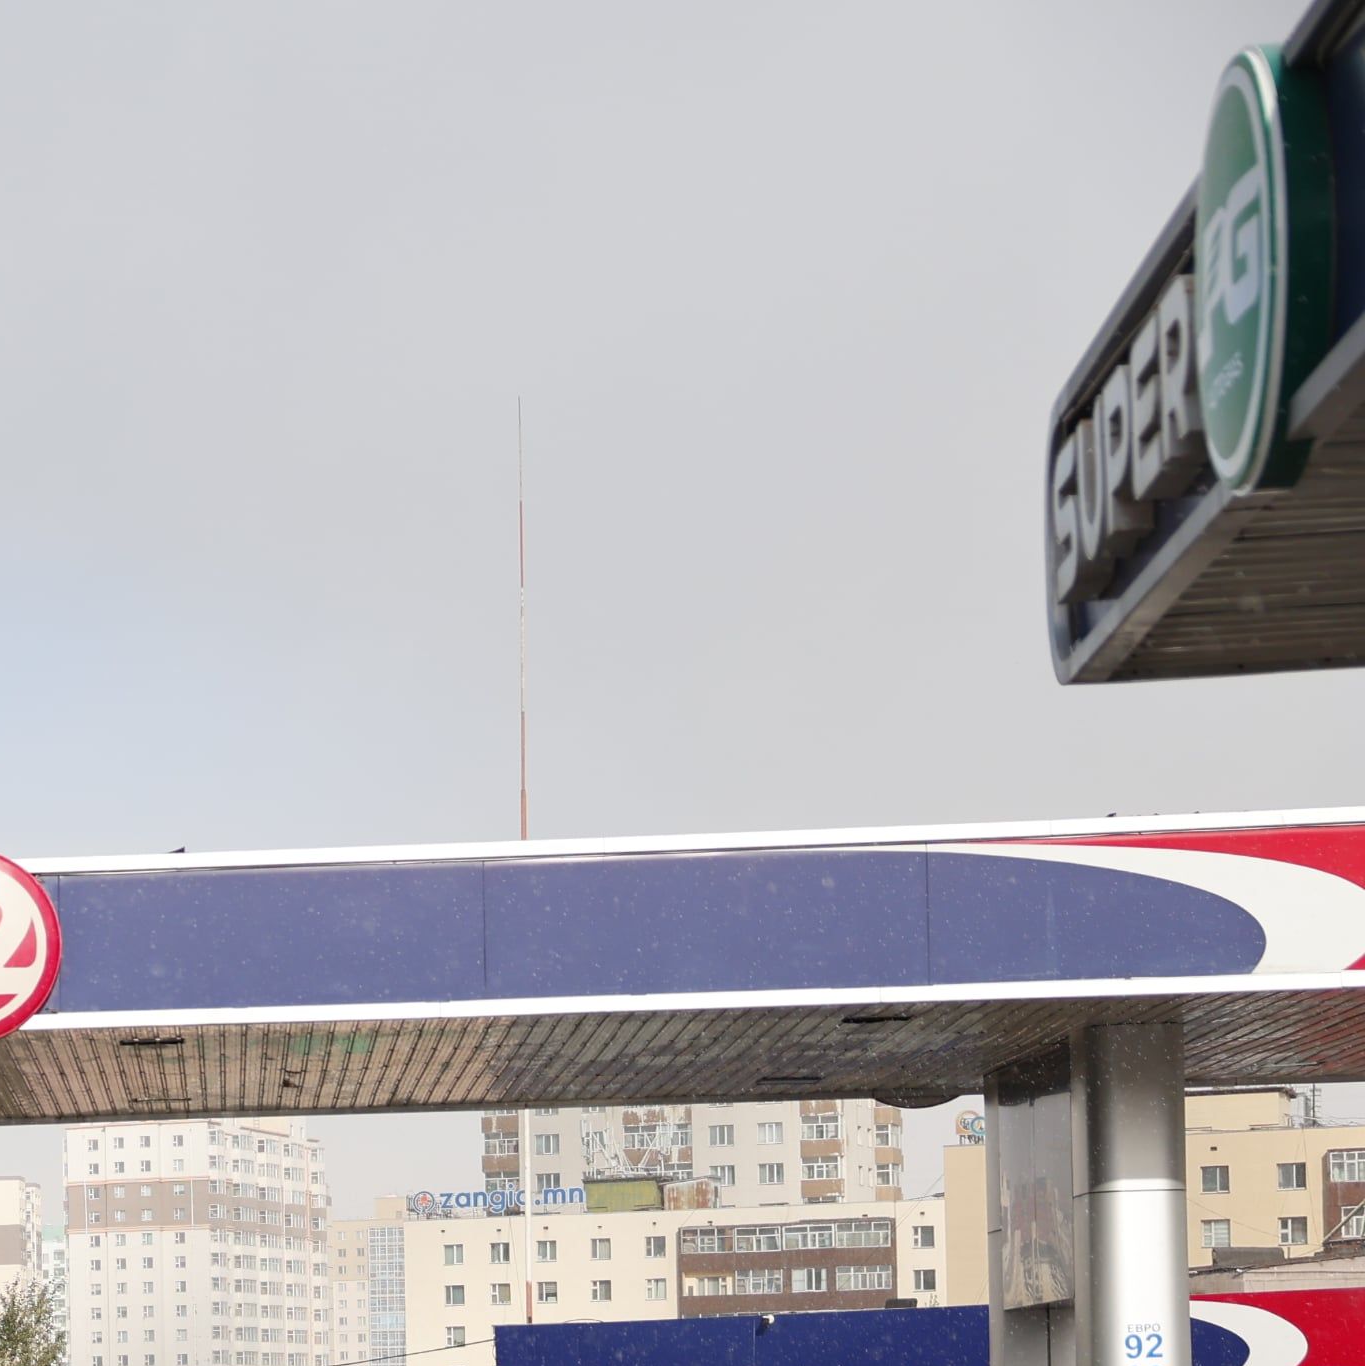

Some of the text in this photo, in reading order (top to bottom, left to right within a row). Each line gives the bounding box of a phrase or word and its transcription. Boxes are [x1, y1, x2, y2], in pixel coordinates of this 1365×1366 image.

[1053, 273, 1193, 604] SUPER
[1127, 1323, 1161, 1333] ЕВРО
[1124, 1333, 1164, 1359] 92
